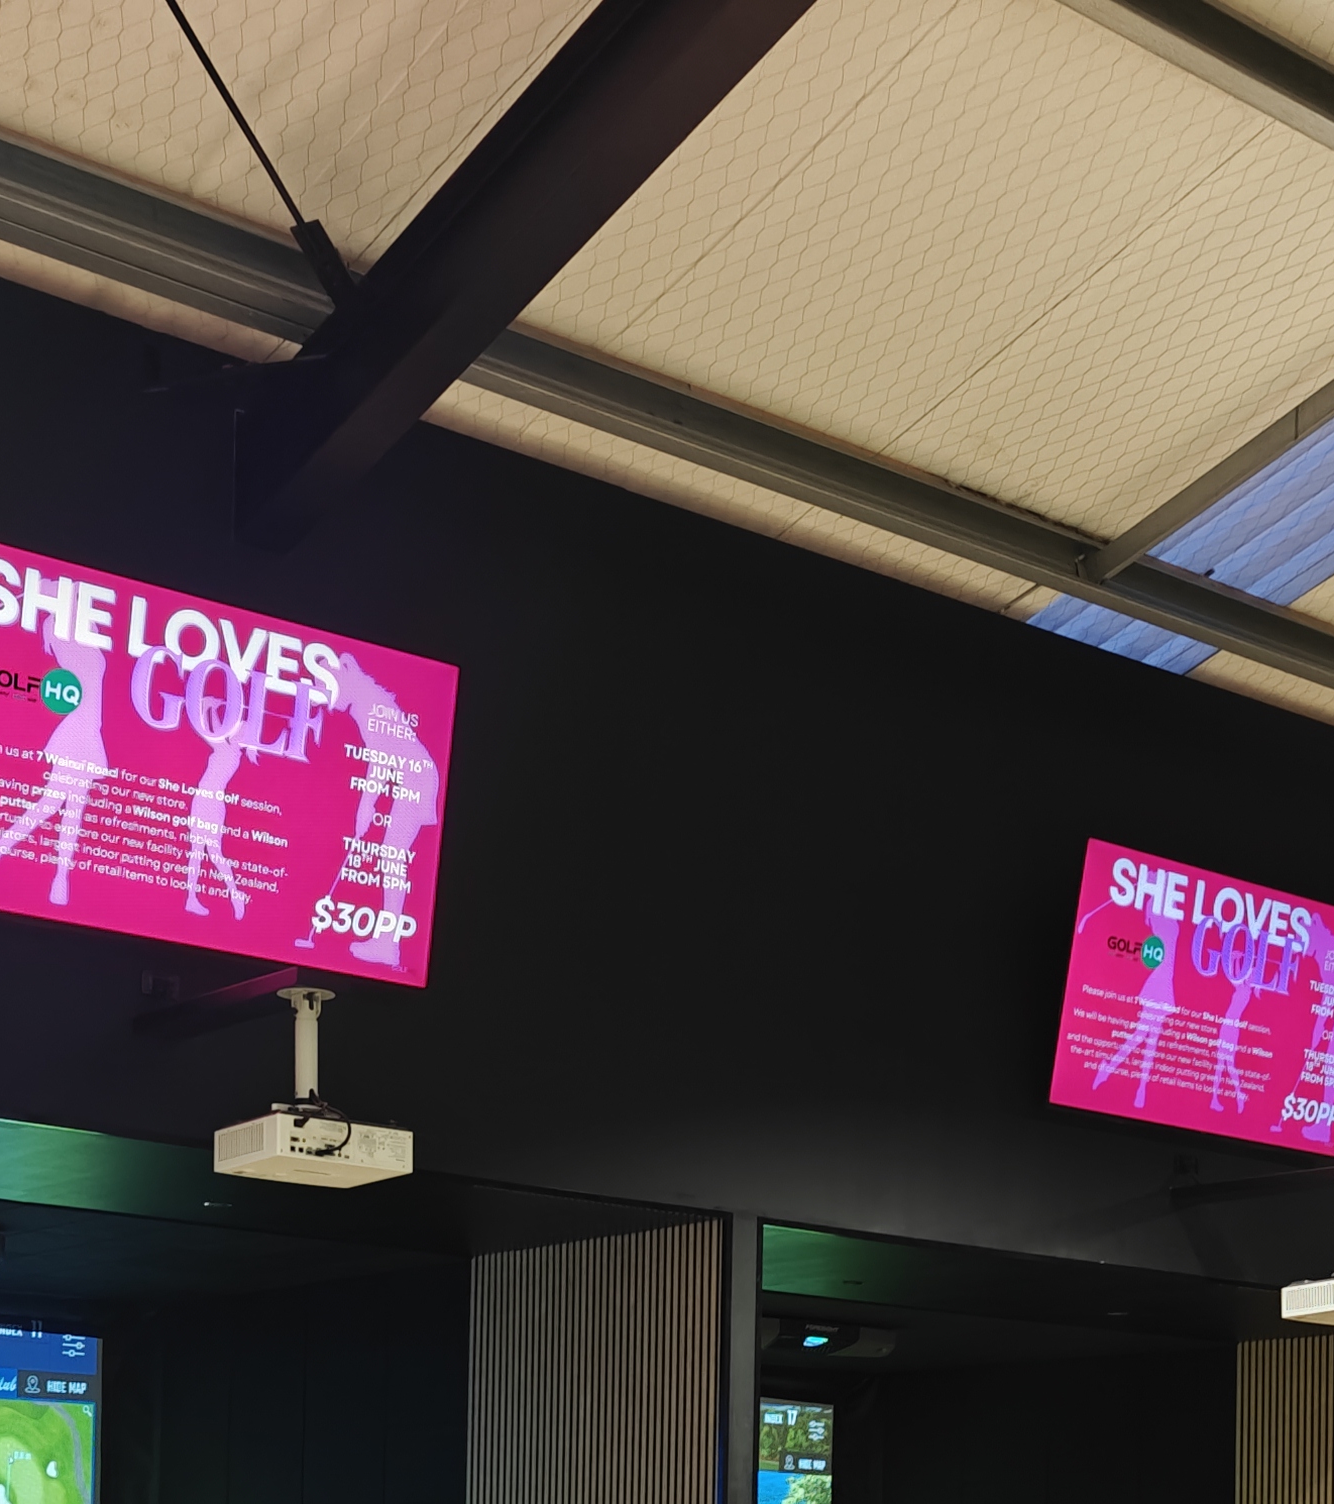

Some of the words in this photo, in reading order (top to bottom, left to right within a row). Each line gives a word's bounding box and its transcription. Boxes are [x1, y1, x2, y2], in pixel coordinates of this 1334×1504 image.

[128, 595, 341, 709] LOVES
[44, 679, 82, 706] HQ
[130, 645, 325, 765] GOLF
[368, 702, 399, 723] JOIN
[400, 710, 419, 728] US
[367, 717, 417, 742] EITHER:
[343, 743, 406, 771] TUESDAY
[369, 764, 404, 785] JUNE
[350, 775, 389, 797] FROM
[391, 785, 421, 805] 5PM
[371, 811, 392, 829] OR
[342, 835, 416, 864] THURSDAY
[340, 867, 380, 888] FROM
[382, 875, 411, 894] 5PM
[373, 858, 408, 878] JUNE
[313, 894, 418, 944] $30PP
[1193, 879, 1313, 954] LOVES
[1192, 916, 1300, 996] GOLF
[69, 1381, 87, 1394] MAP
[787, 1409, 798, 1425] 17
